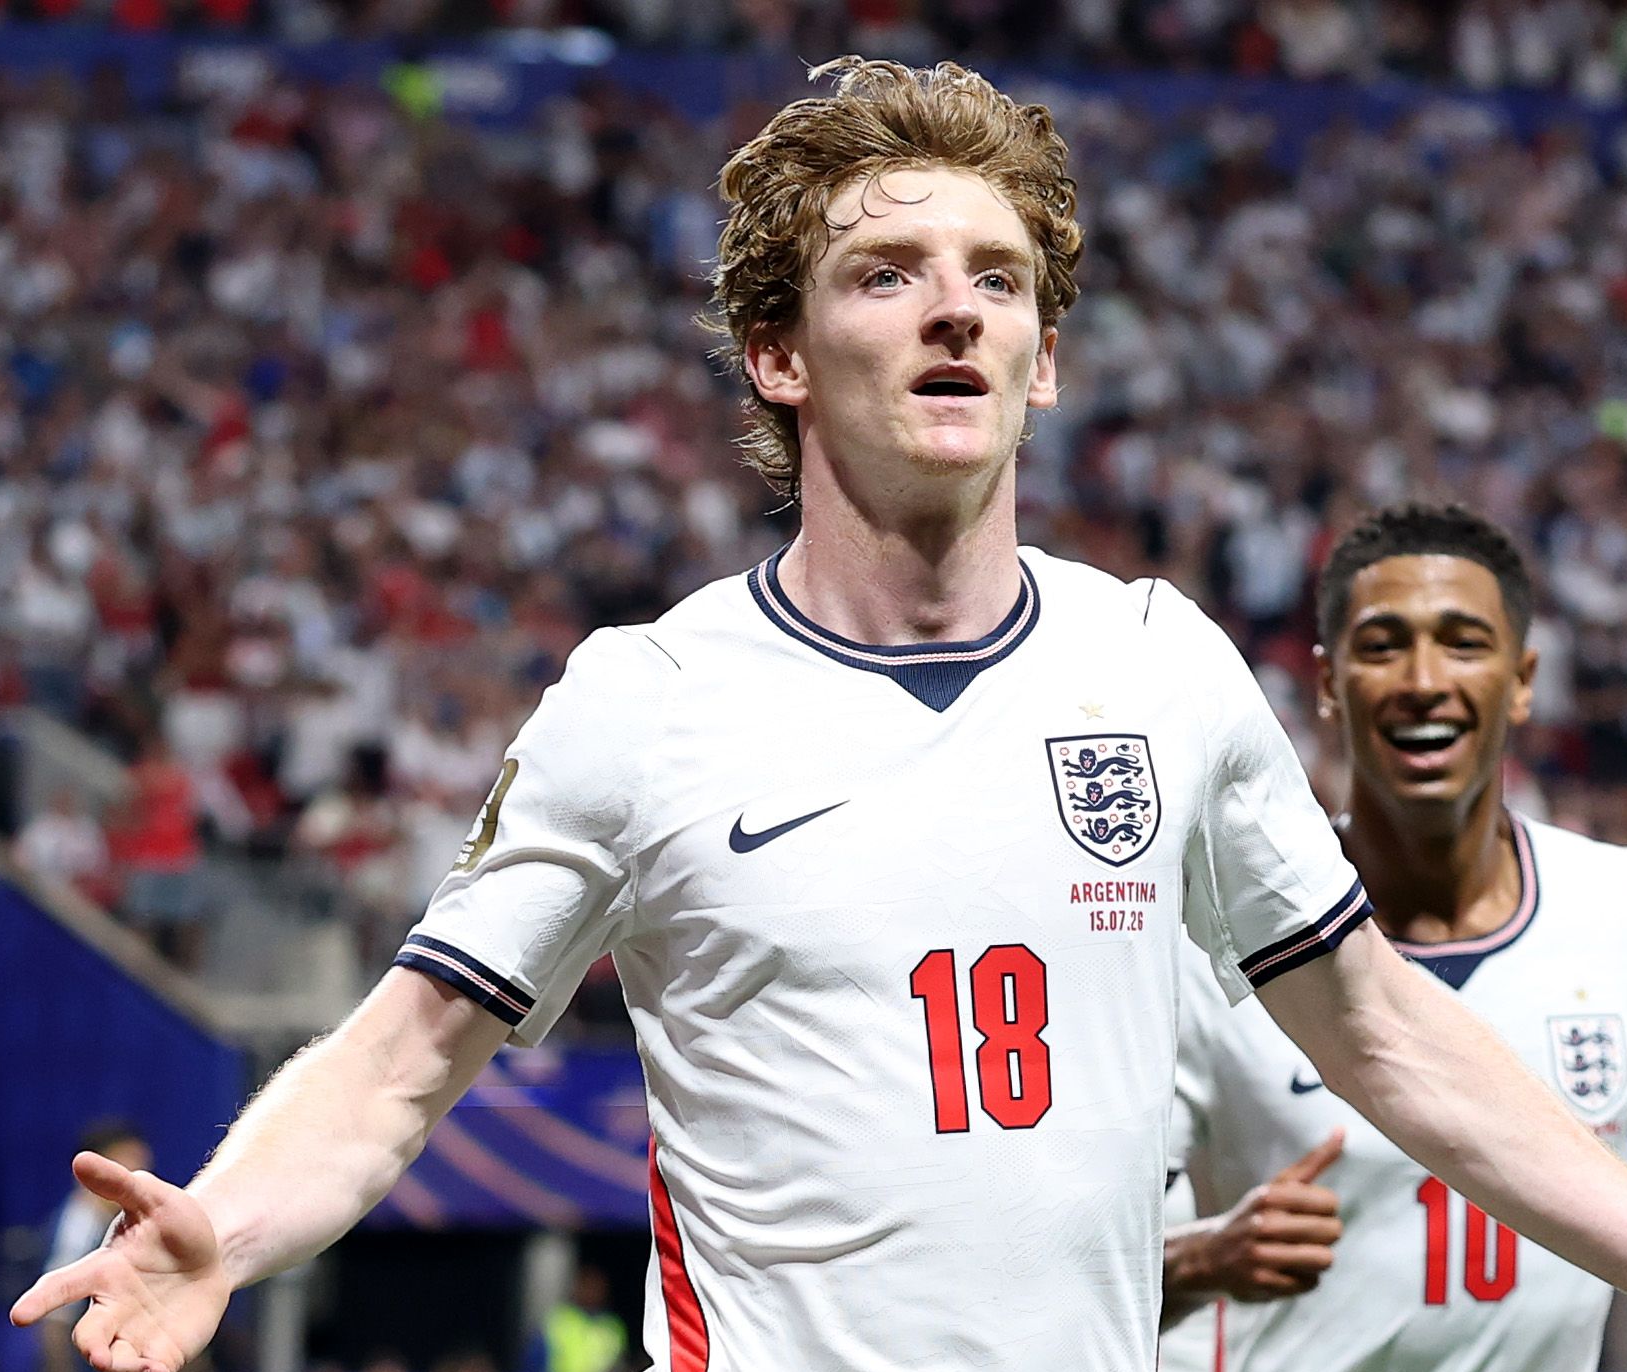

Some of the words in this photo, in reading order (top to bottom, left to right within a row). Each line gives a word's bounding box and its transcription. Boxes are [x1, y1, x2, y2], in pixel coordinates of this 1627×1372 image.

[1070, 881, 1157, 904] ARGENTINA
[1089, 910, 1144, 932] 15.07.26
[909, 943, 1053, 1135] 18
[1416, 1175, 1518, 1306] 10
